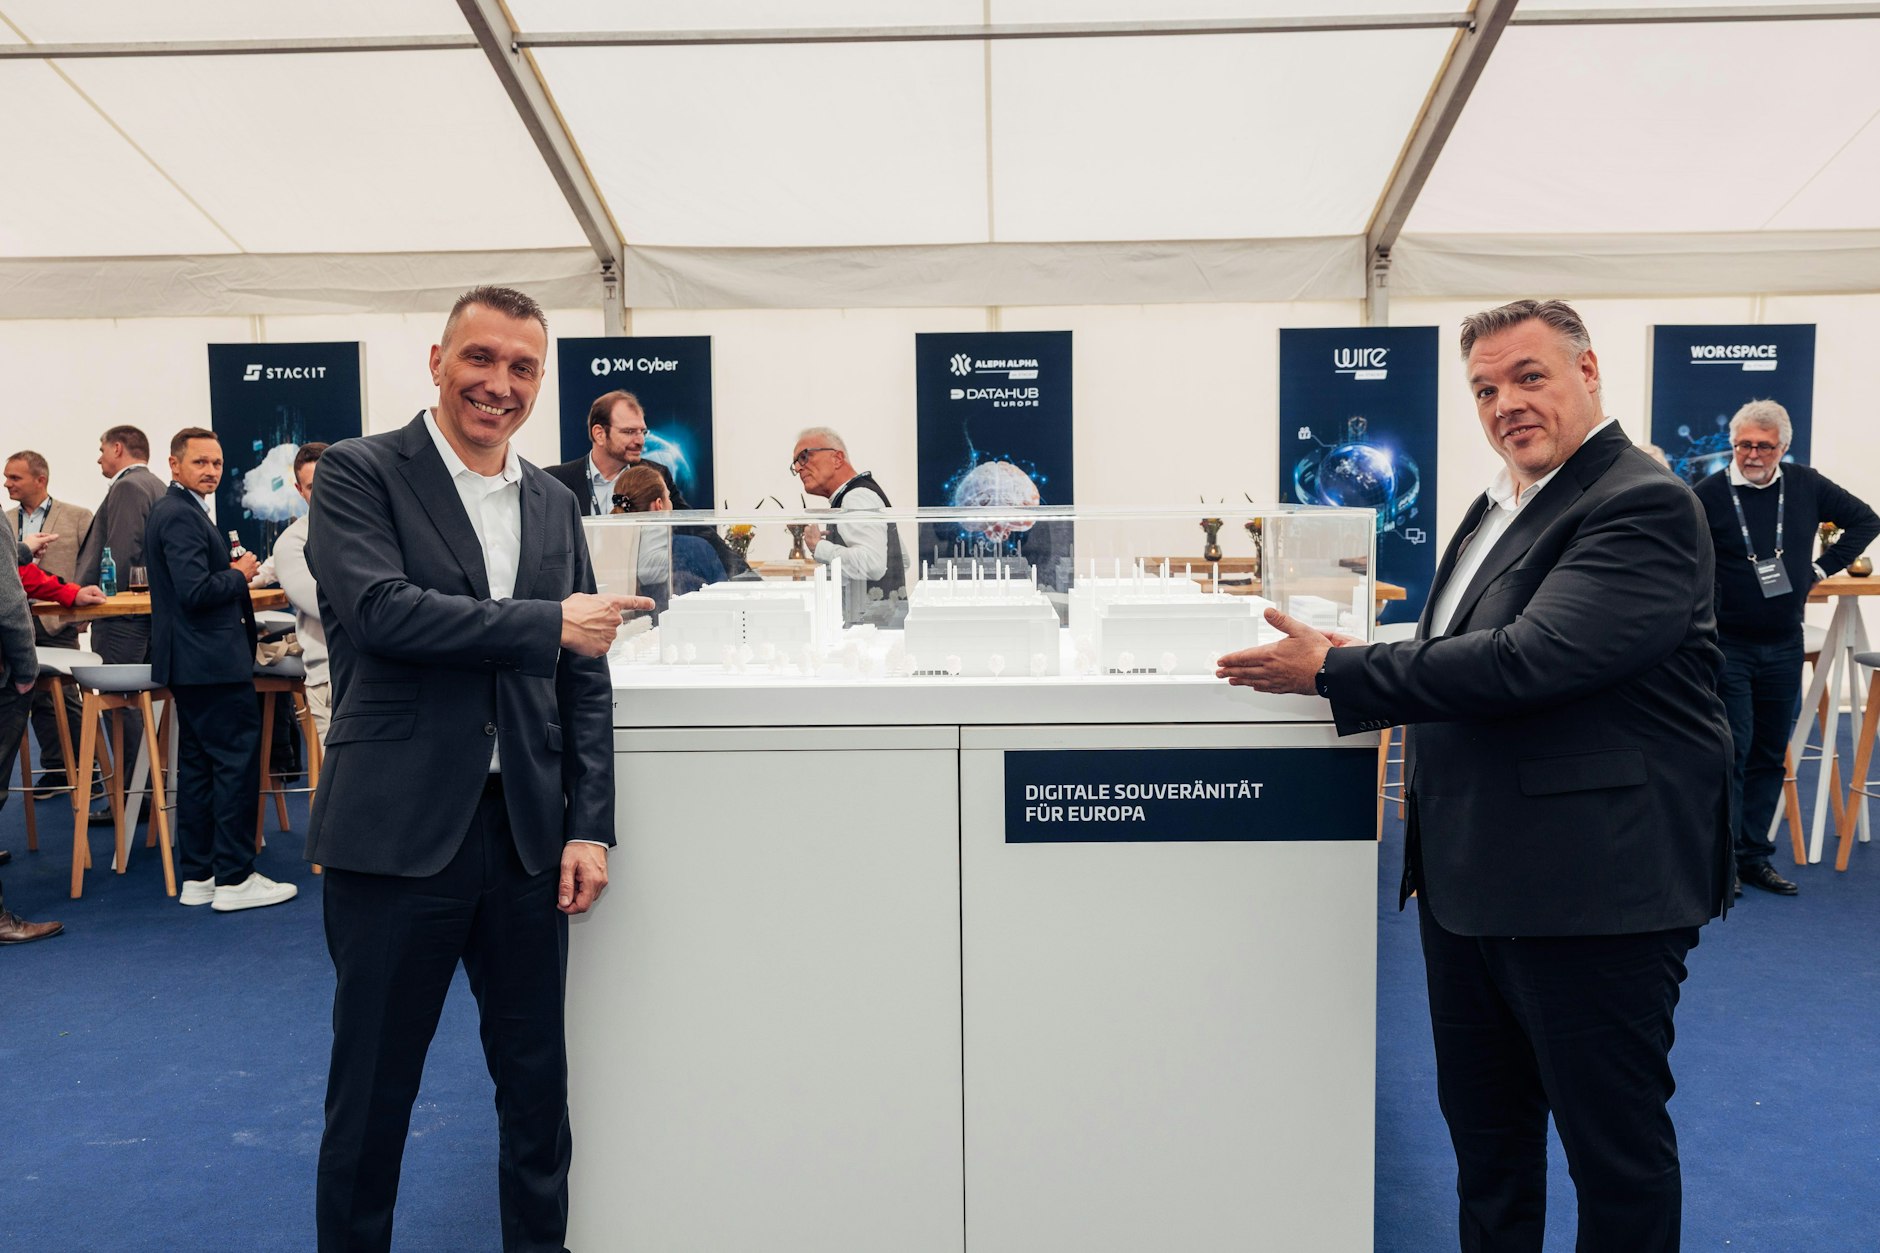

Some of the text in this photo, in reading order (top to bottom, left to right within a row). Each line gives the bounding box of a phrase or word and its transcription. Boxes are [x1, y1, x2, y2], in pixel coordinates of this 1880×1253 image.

[1690, 345, 1777, 358] WORKSPACE
[613, 357, 678, 374] XM Cyber
[975, 359, 1038, 368] ALEPH ALPHA
[266, 367, 326, 379] STACKIT
[967, 388, 1039, 399] DATAHUB
[1025, 780, 1263, 800] DIGITALE SOUVERÄNITÄT
[1025, 803, 1146, 822] FÜR EUROPA
